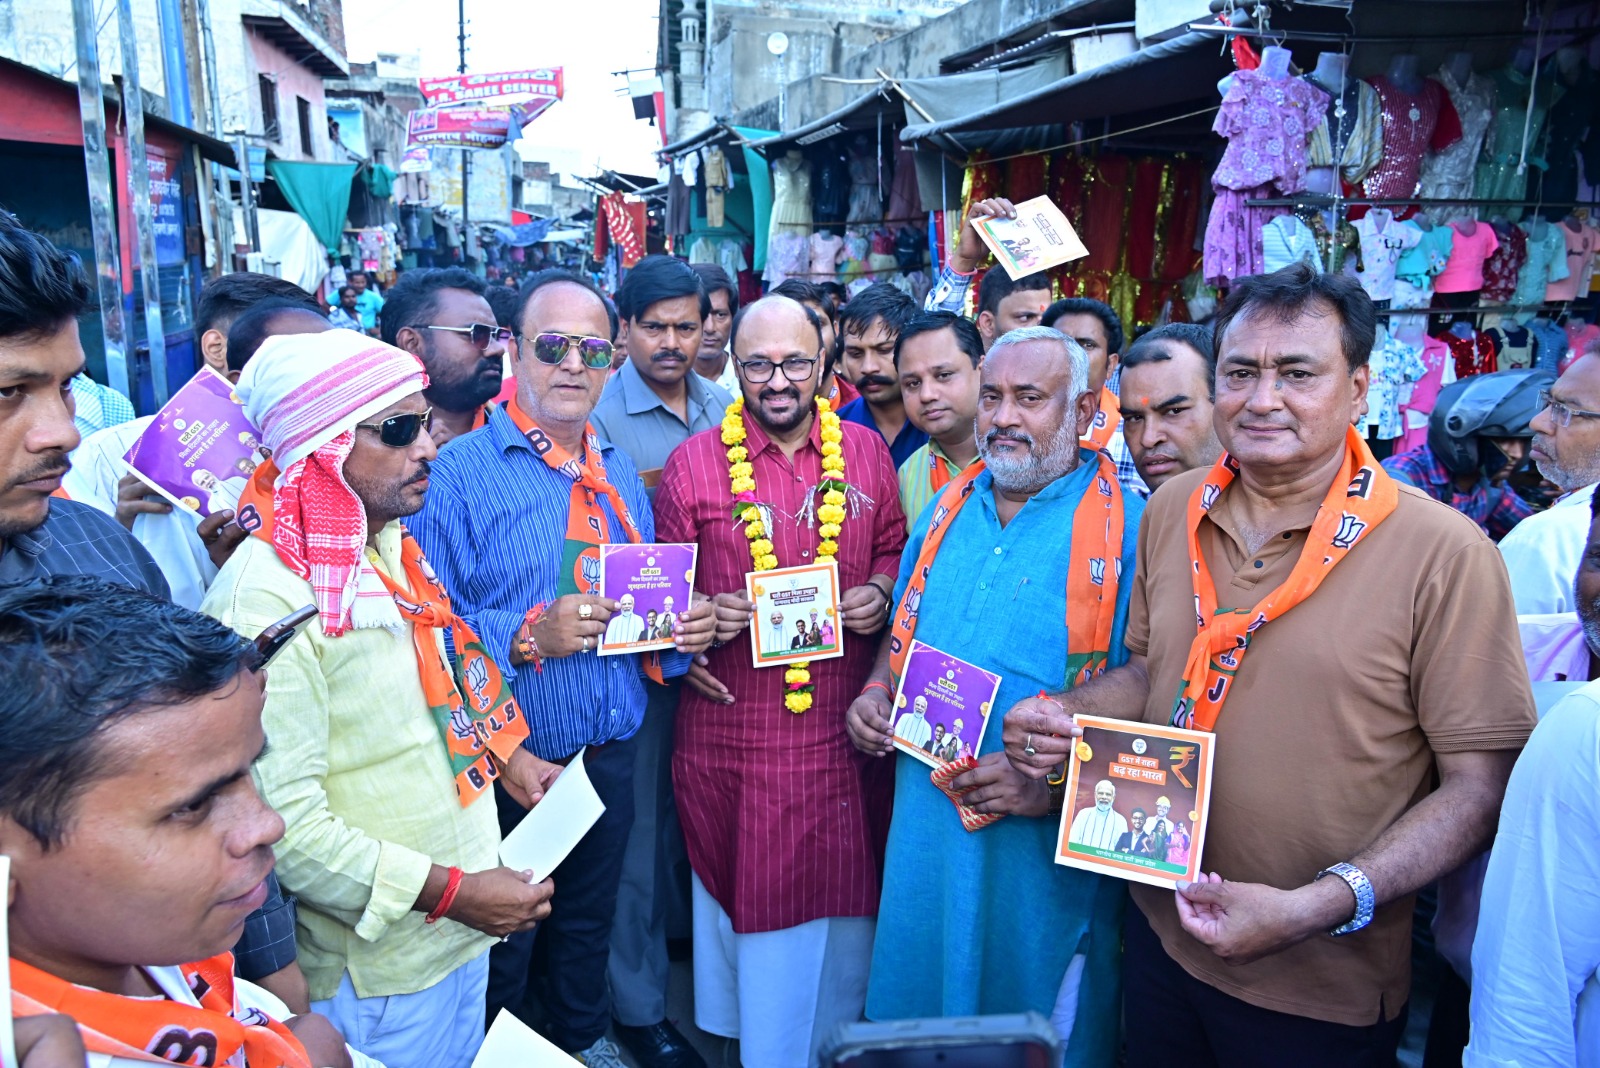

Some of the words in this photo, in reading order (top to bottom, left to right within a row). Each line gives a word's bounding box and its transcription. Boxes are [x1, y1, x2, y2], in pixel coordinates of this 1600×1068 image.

[455, 85, 500, 100] SAREE
[502, 83, 557, 96] CENTER
[182, 430, 192, 442] घटी
[191, 424, 201, 434] GST
[212, 421, 229, 438] परिवार
[1142, 760, 1156, 768] राहत
[1114, 766, 1126, 777] बढ़
[1127, 768, 1140, 778] रहा
[1141, 771, 1163, 781] भारत
